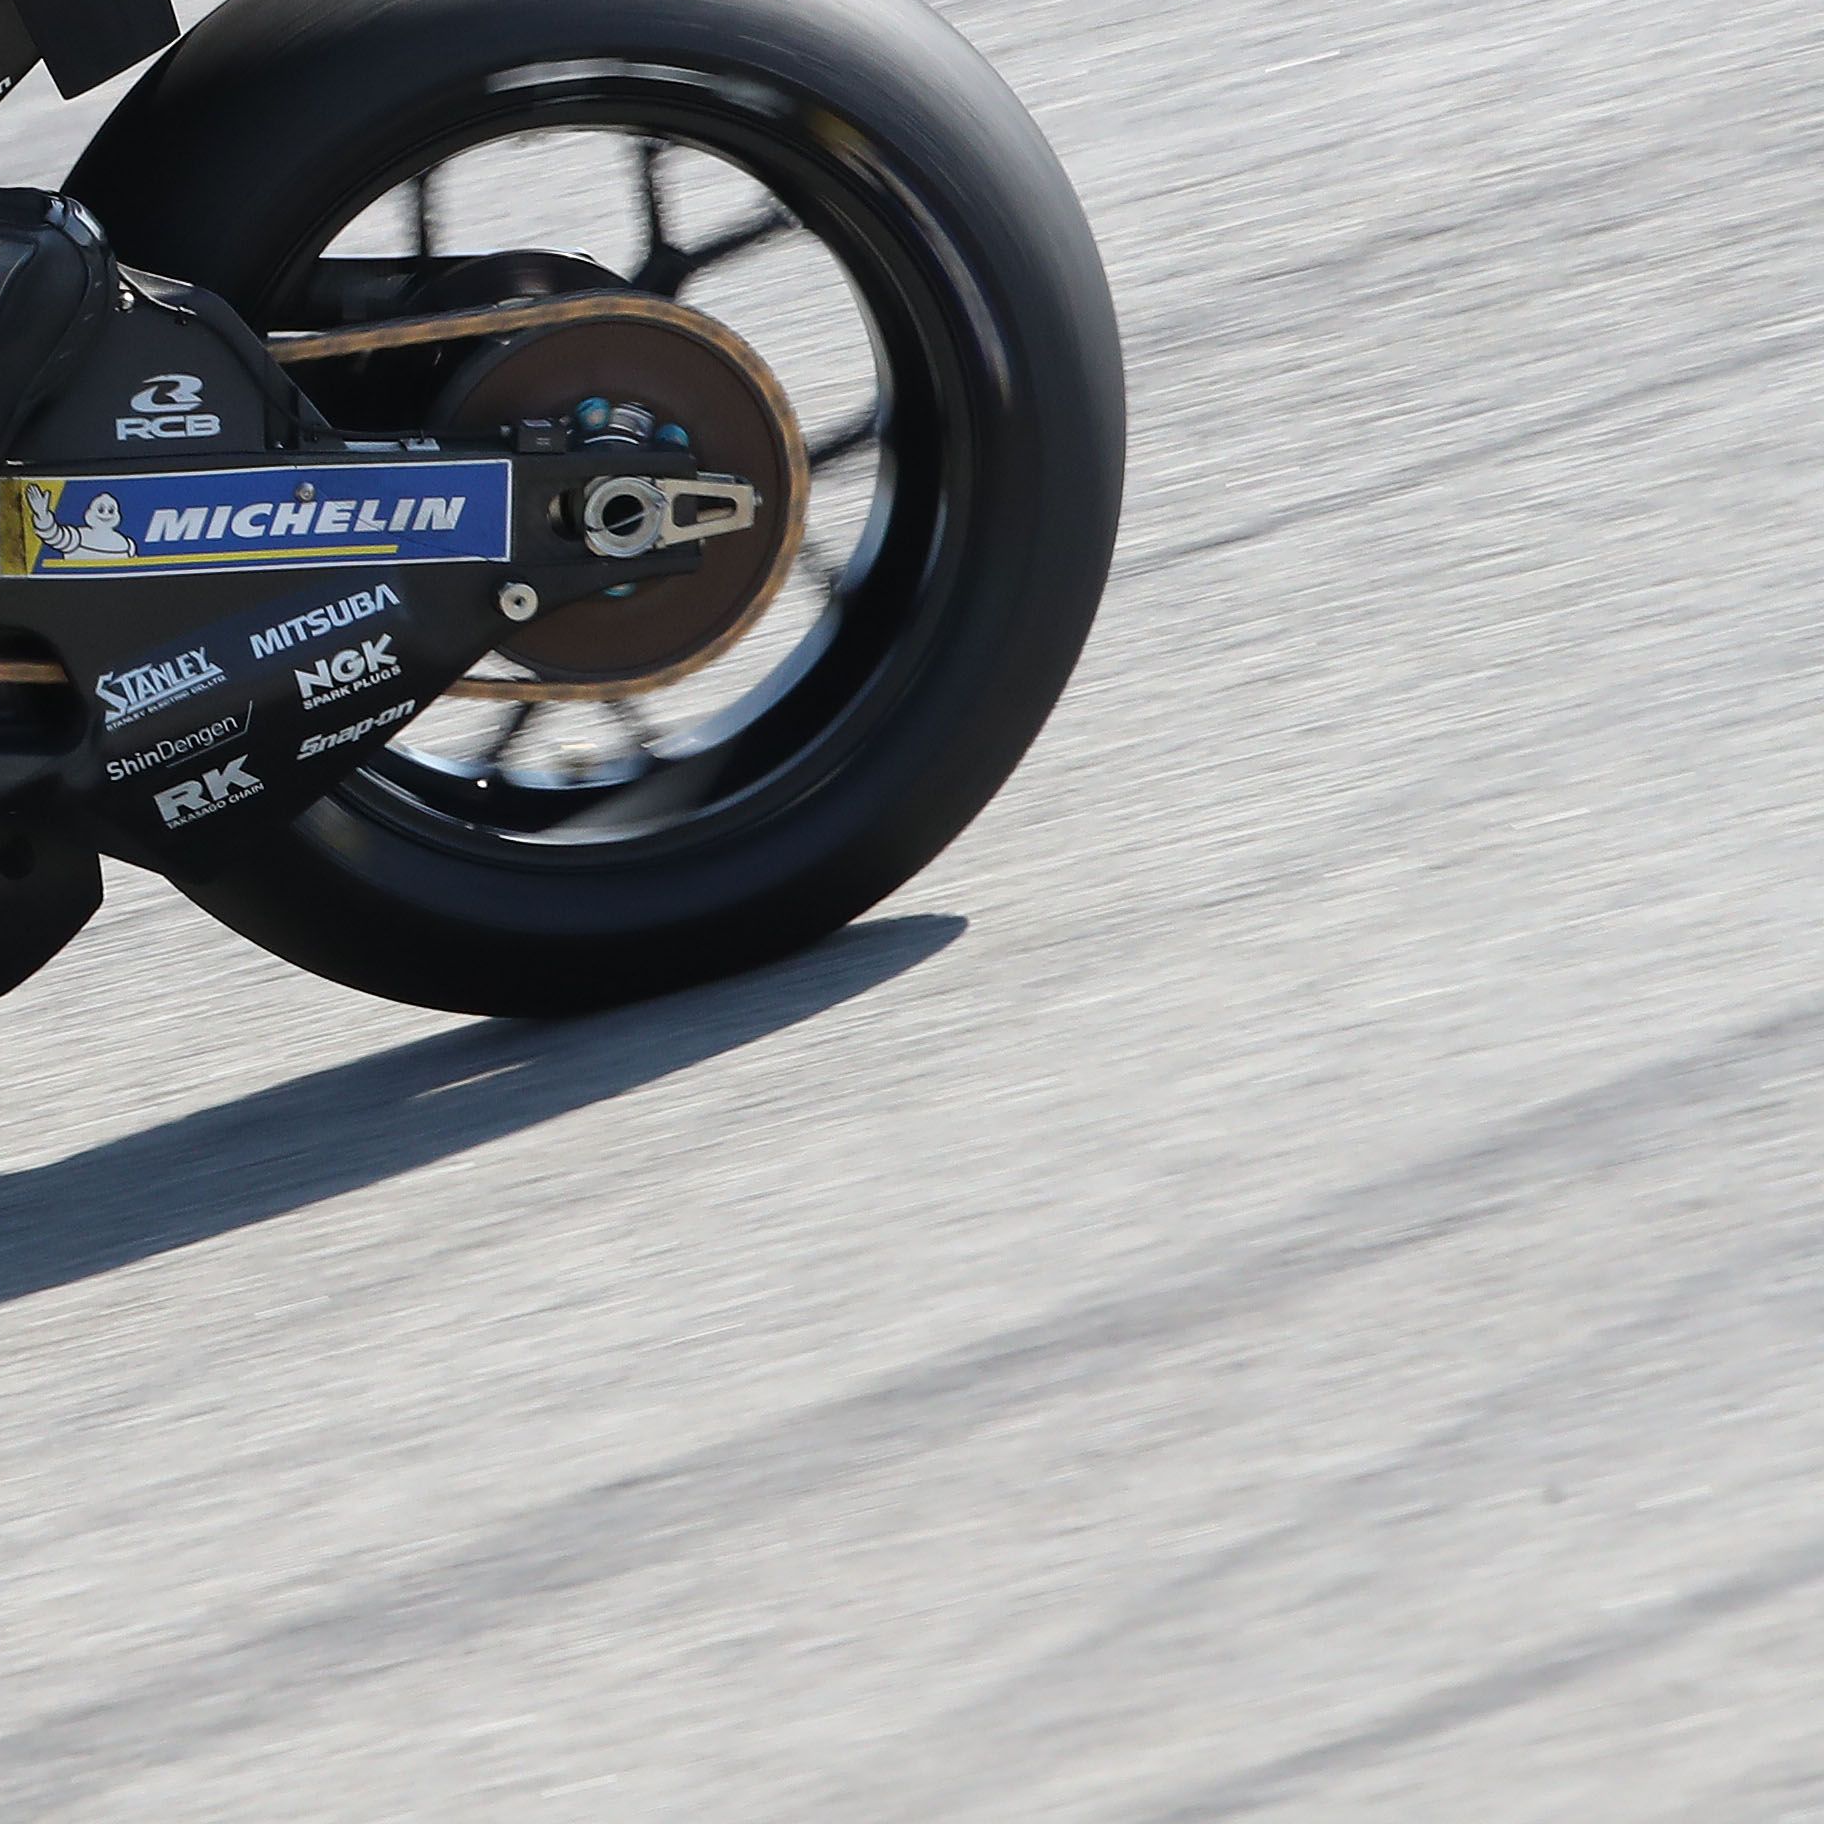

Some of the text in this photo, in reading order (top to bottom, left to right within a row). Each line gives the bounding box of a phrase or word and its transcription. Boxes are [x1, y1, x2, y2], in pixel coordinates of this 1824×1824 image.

[115, 413, 222, 442] RCB
[144, 495, 467, 543] MICHELIN
[249, 583, 401, 660] MITSUBA
[95, 646, 220, 725] STANLEY
[294, 632, 398, 700] NGK
[303, 664, 402, 711] SPARK PLUGS
[106, 716, 239, 781] ShinDengen
[296, 698, 417, 761] Snap-on
[153, 753, 262, 823] RK
